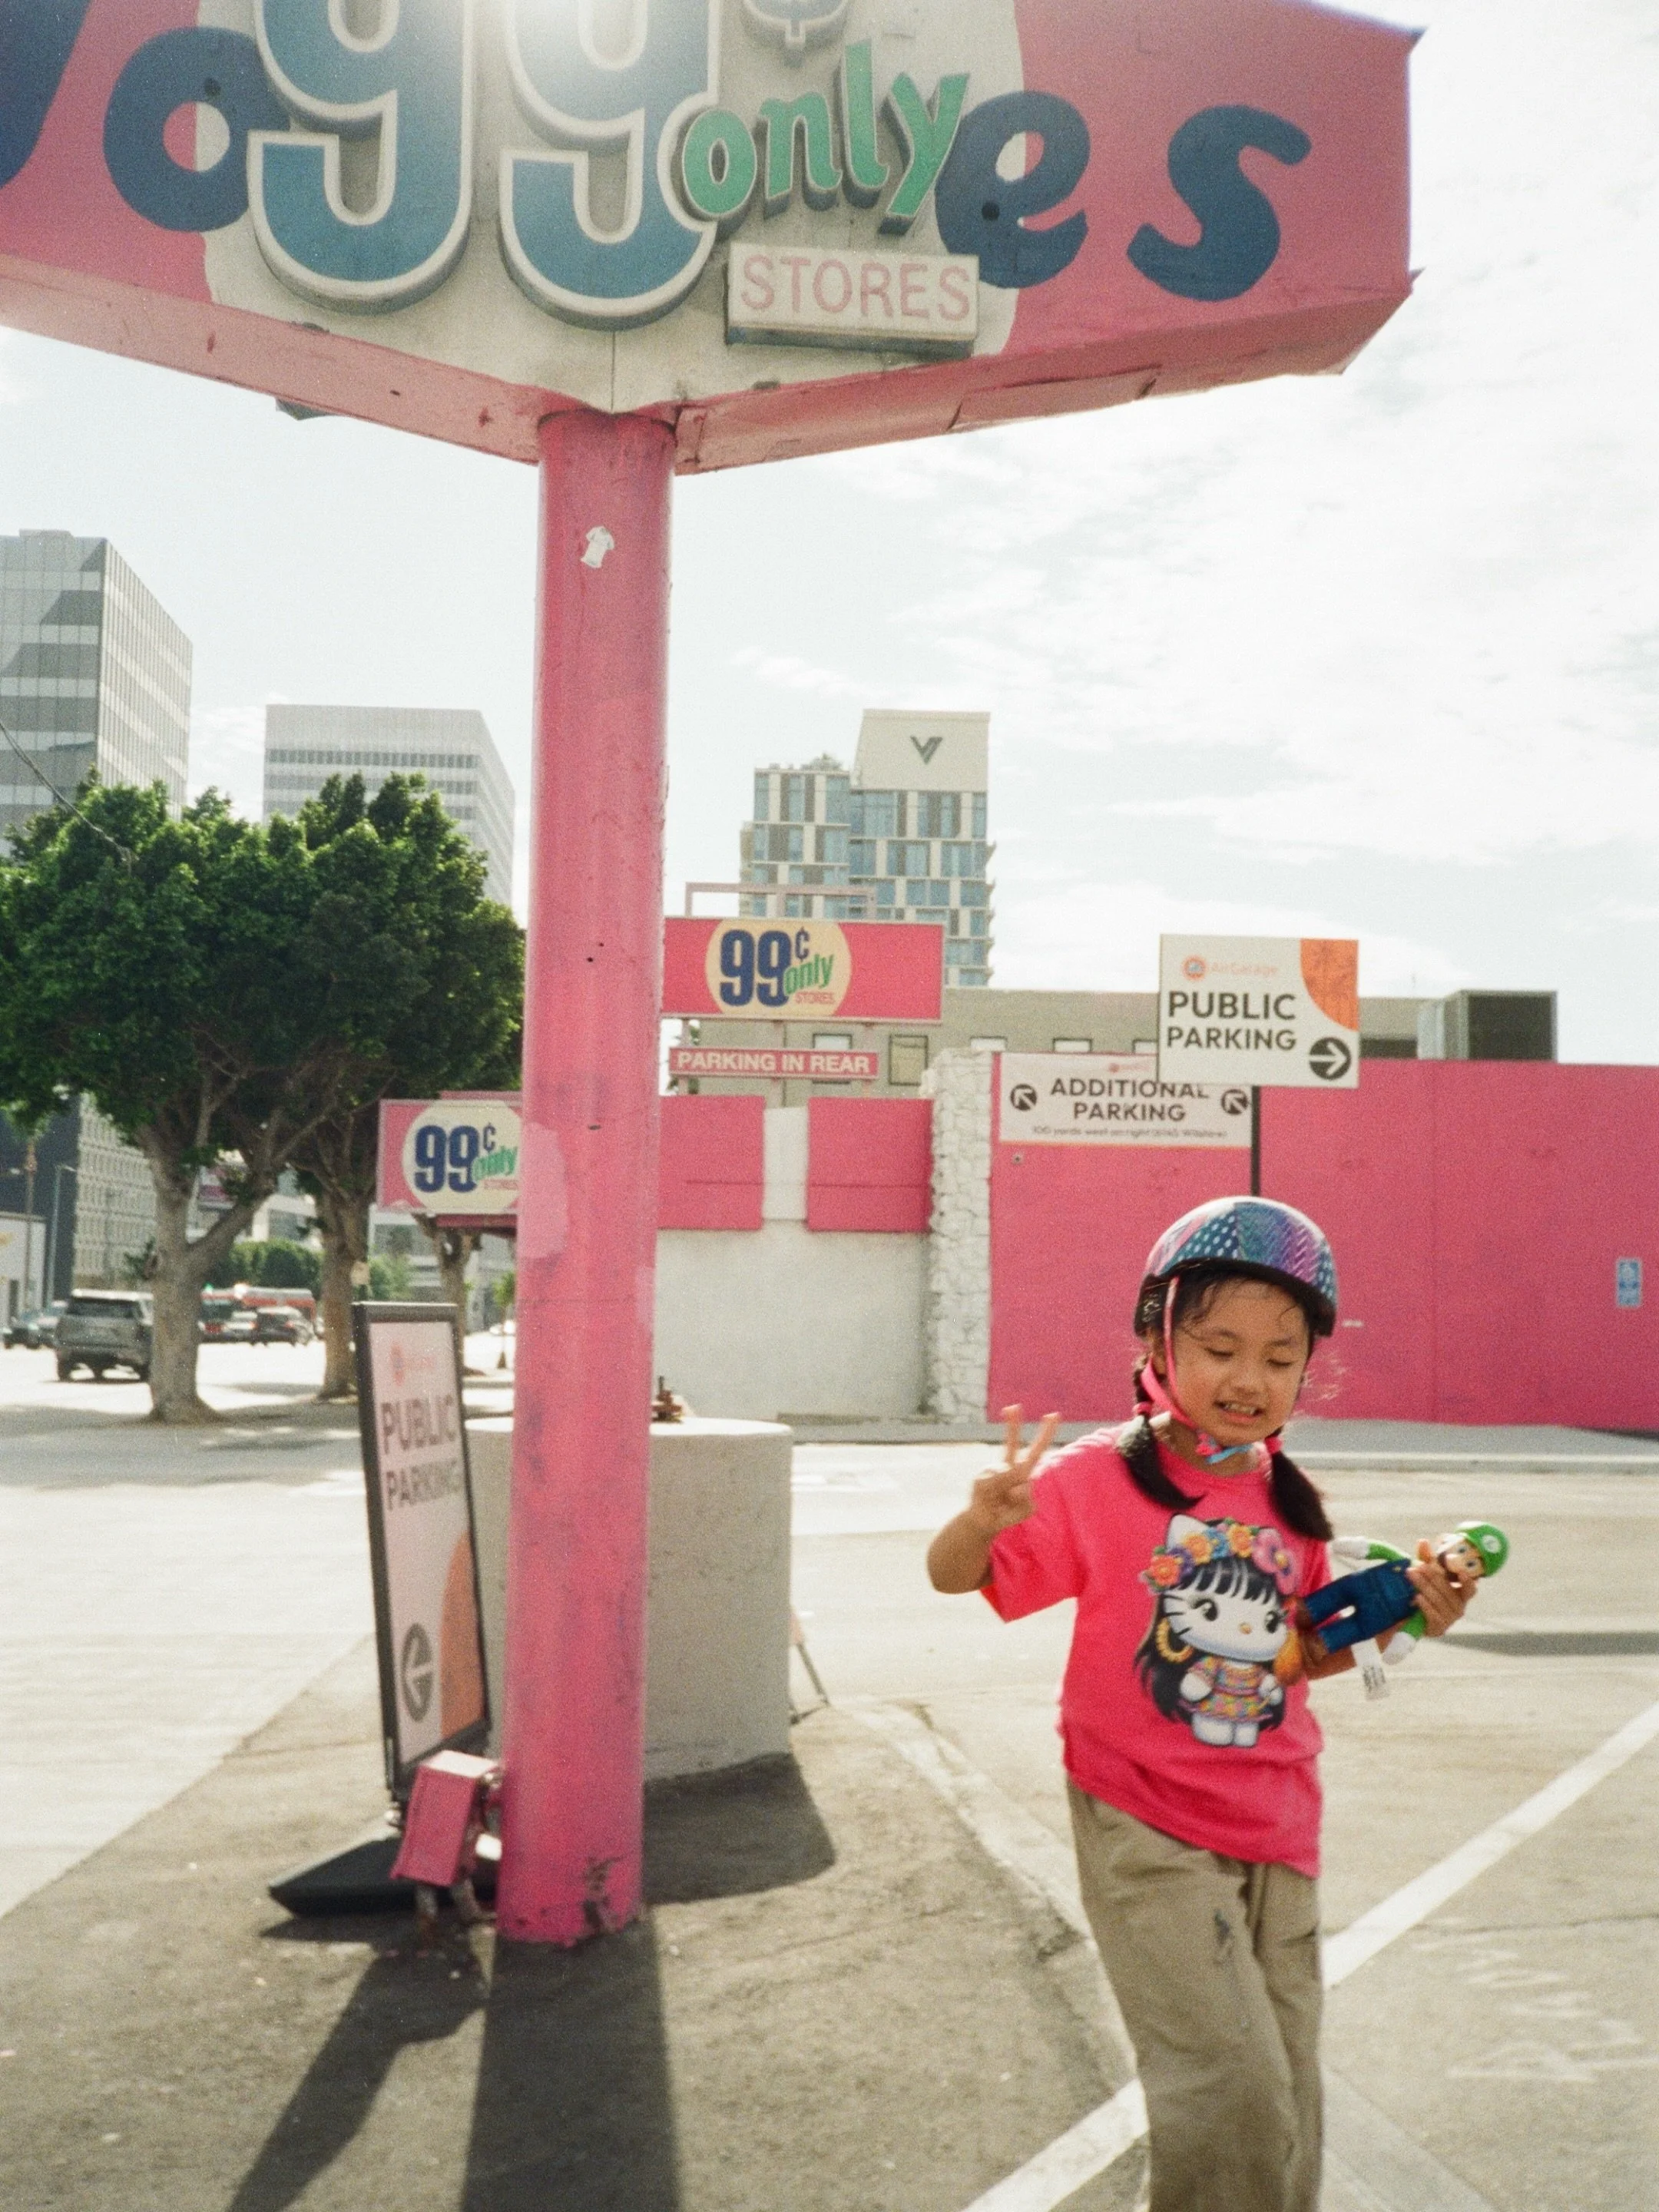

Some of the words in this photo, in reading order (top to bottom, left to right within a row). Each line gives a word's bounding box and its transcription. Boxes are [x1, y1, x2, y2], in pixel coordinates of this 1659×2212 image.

[682, 38, 970, 218] only
[740, 254, 971, 322] STORES
[783, 952, 834, 995] only
[1168, 990, 1296, 1020] PUBLIC
[1167, 1025, 1297, 1051] PARKING
[677, 1051, 777, 1071] PARKING
[782, 1053, 805, 1072] IN
[810, 1055, 870, 1074] REAR
[1050, 1078, 1209, 1099] ADDITIONAL
[1073, 1102, 1187, 1122] PARKING
[381, 1393, 456, 1455] PUBLIC
[386, 1459, 462, 1512] PARKING
